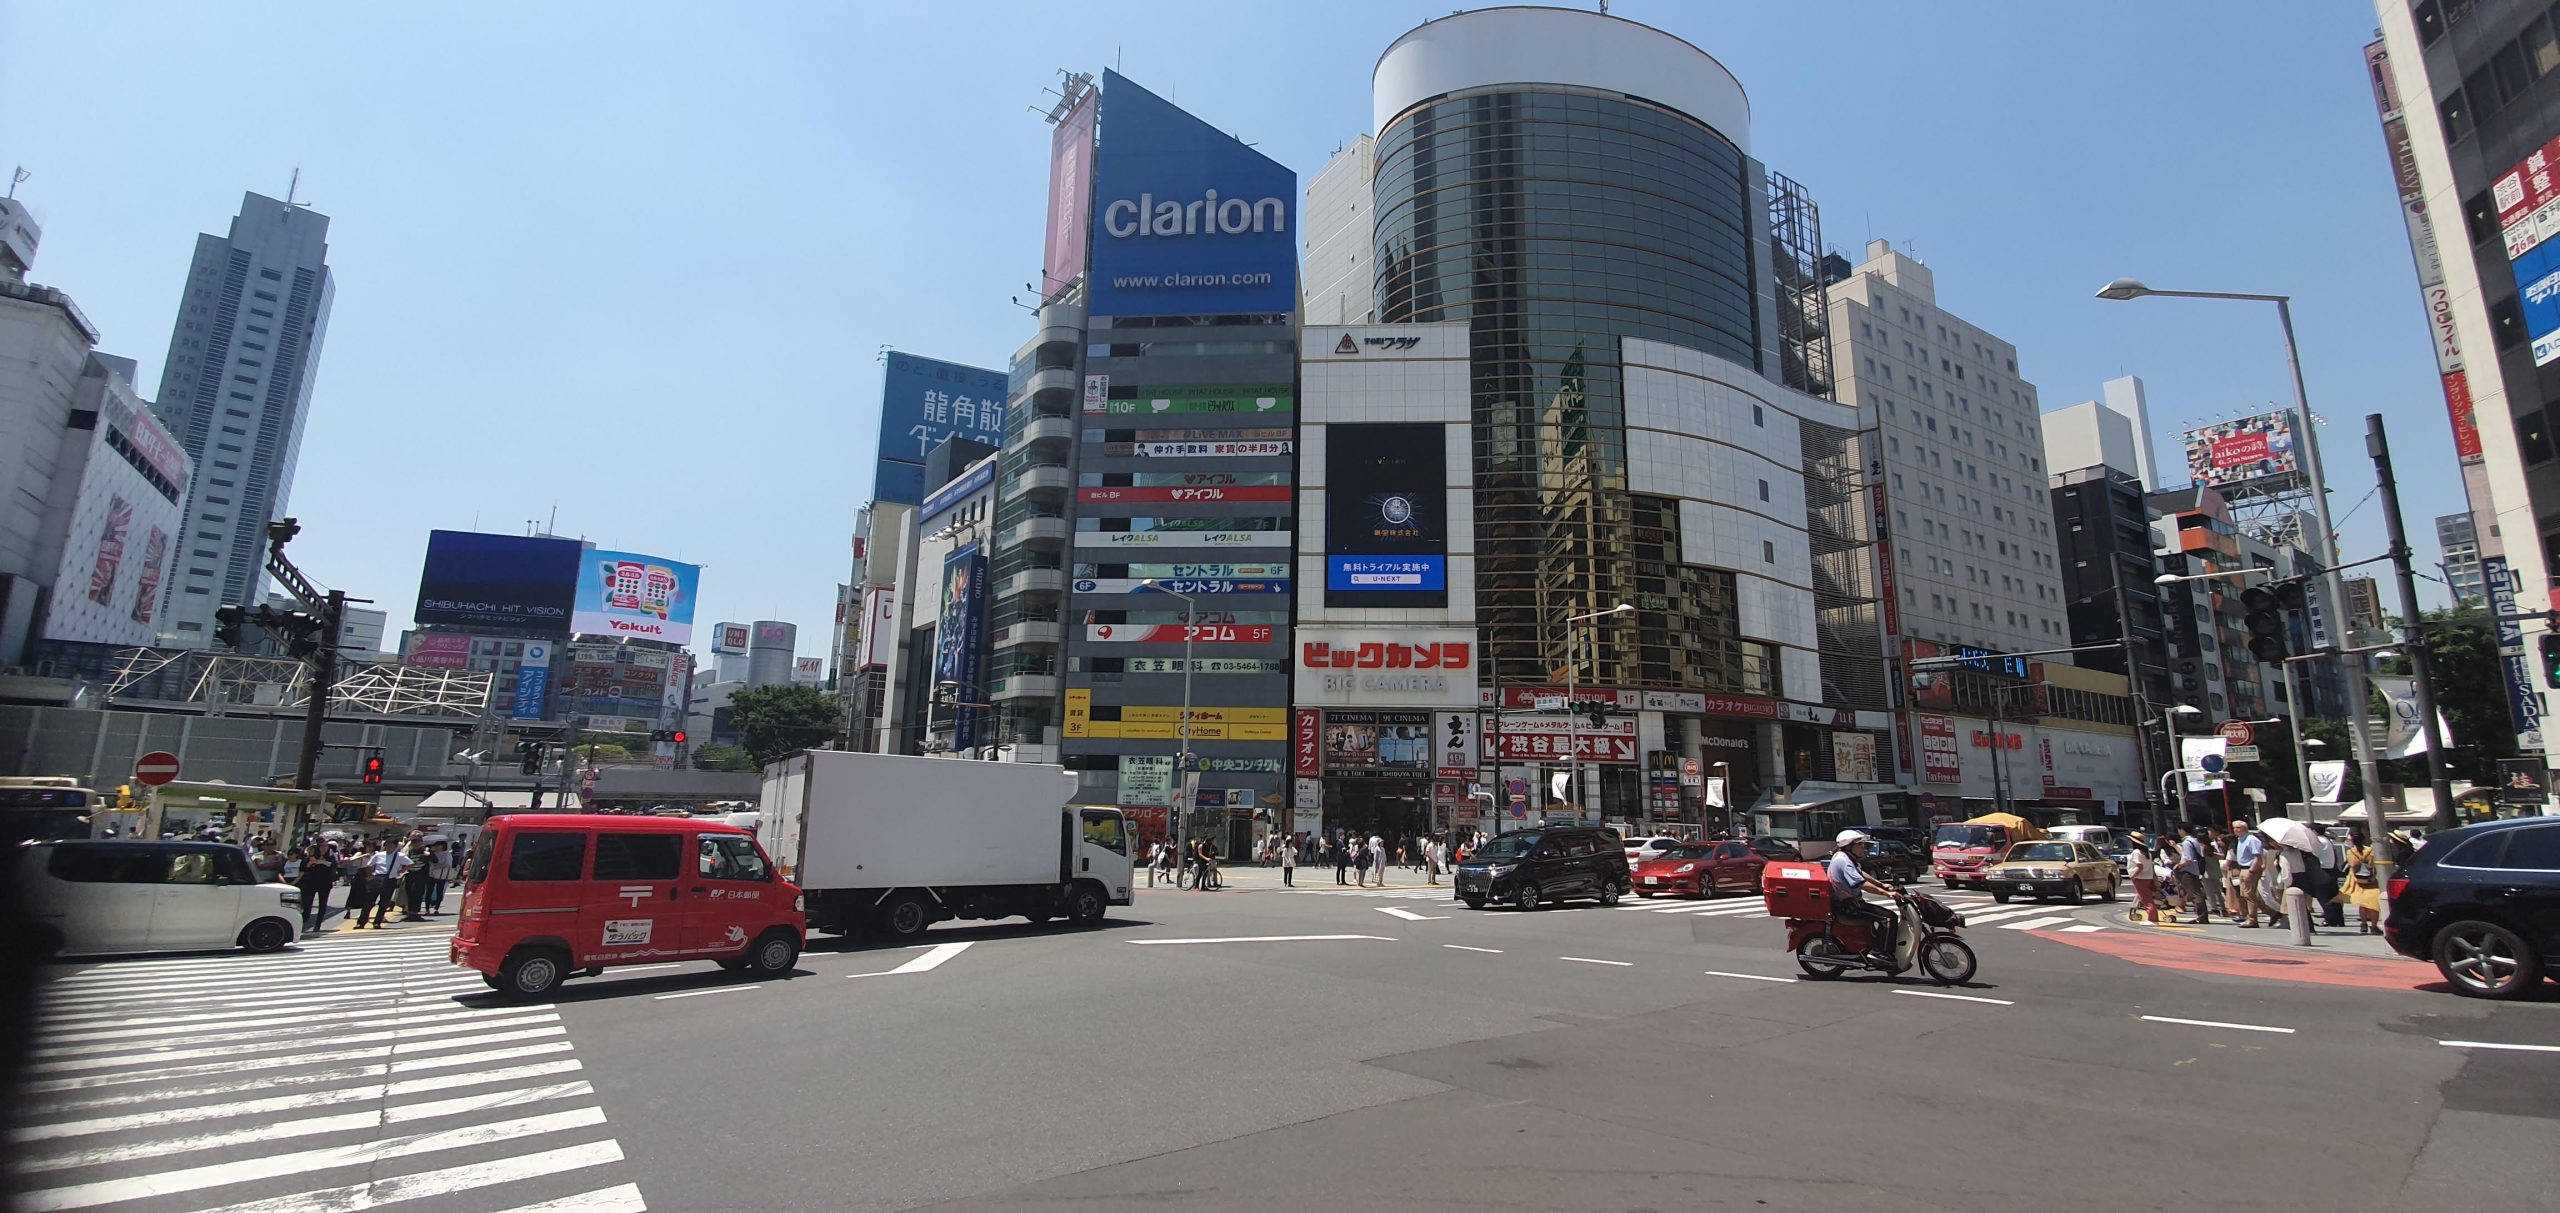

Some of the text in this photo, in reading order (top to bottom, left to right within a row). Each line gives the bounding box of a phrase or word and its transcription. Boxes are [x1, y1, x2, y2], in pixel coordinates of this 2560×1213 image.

[1104, 188, 1285, 238] clarion
[1113, 271, 1272, 288] www.clarion.com
[1153, 443, 1279, 455] 仲介手数料 家賃の半月分
[1197, 474, 1236, 485] アイフル
[1184, 489, 1224, 500] アイフル
[1111, 534, 1159, 543] レイクALSA
[1204, 534, 1252, 543] レイクALSA
[1172, 565, 1234, 577] セントラル
[1270, 566, 1284, 576] 6F
[1343, 563, 1430, 572] 無料トライアル実施中
[1079, 582, 1092, 591] 6F
[1172, 580, 1234, 593] セントラル
[423, 599, 565, 617] SHIBUHACHI HIT VISION
[1194, 611, 1236, 624] アコム
[609, 620, 663, 635] Yakult
[728, 629, 745, 638] UNI
[1183, 626, 1270, 641] アコム 5F
[727, 637, 745, 646] QLO
[1303, 642, 1469, 669] ビックカメラ
[1134, 660, 1203, 672] 衣笠眼科
[1361, 675, 1449, 693] CAMERA
[518, 670, 535, 714] アイシティ
[529, 671, 544, 714] コンタクトの
[1624, 695, 1636, 705] 1F
[1706, 699, 1742, 712] カラオケ
[2519, 684, 2539, 727] SADA
[1341, 714, 1374, 722] CINEMA
[1070, 722, 1082, 732] 3F
[1178, 726, 1222, 736] CtyHome
[1447, 714, 1465, 749] えん
[1300, 714, 1315, 768] カラオケ
[1511, 735, 1611, 755] 渋谷最大級
[1700, 735, 1750, 749] McDonald's
[1211, 758, 1281, 771] 中央コンタクト
[727, 890, 761, 900] 日本郵便
[608, 930, 648, 941] ゆうパック
